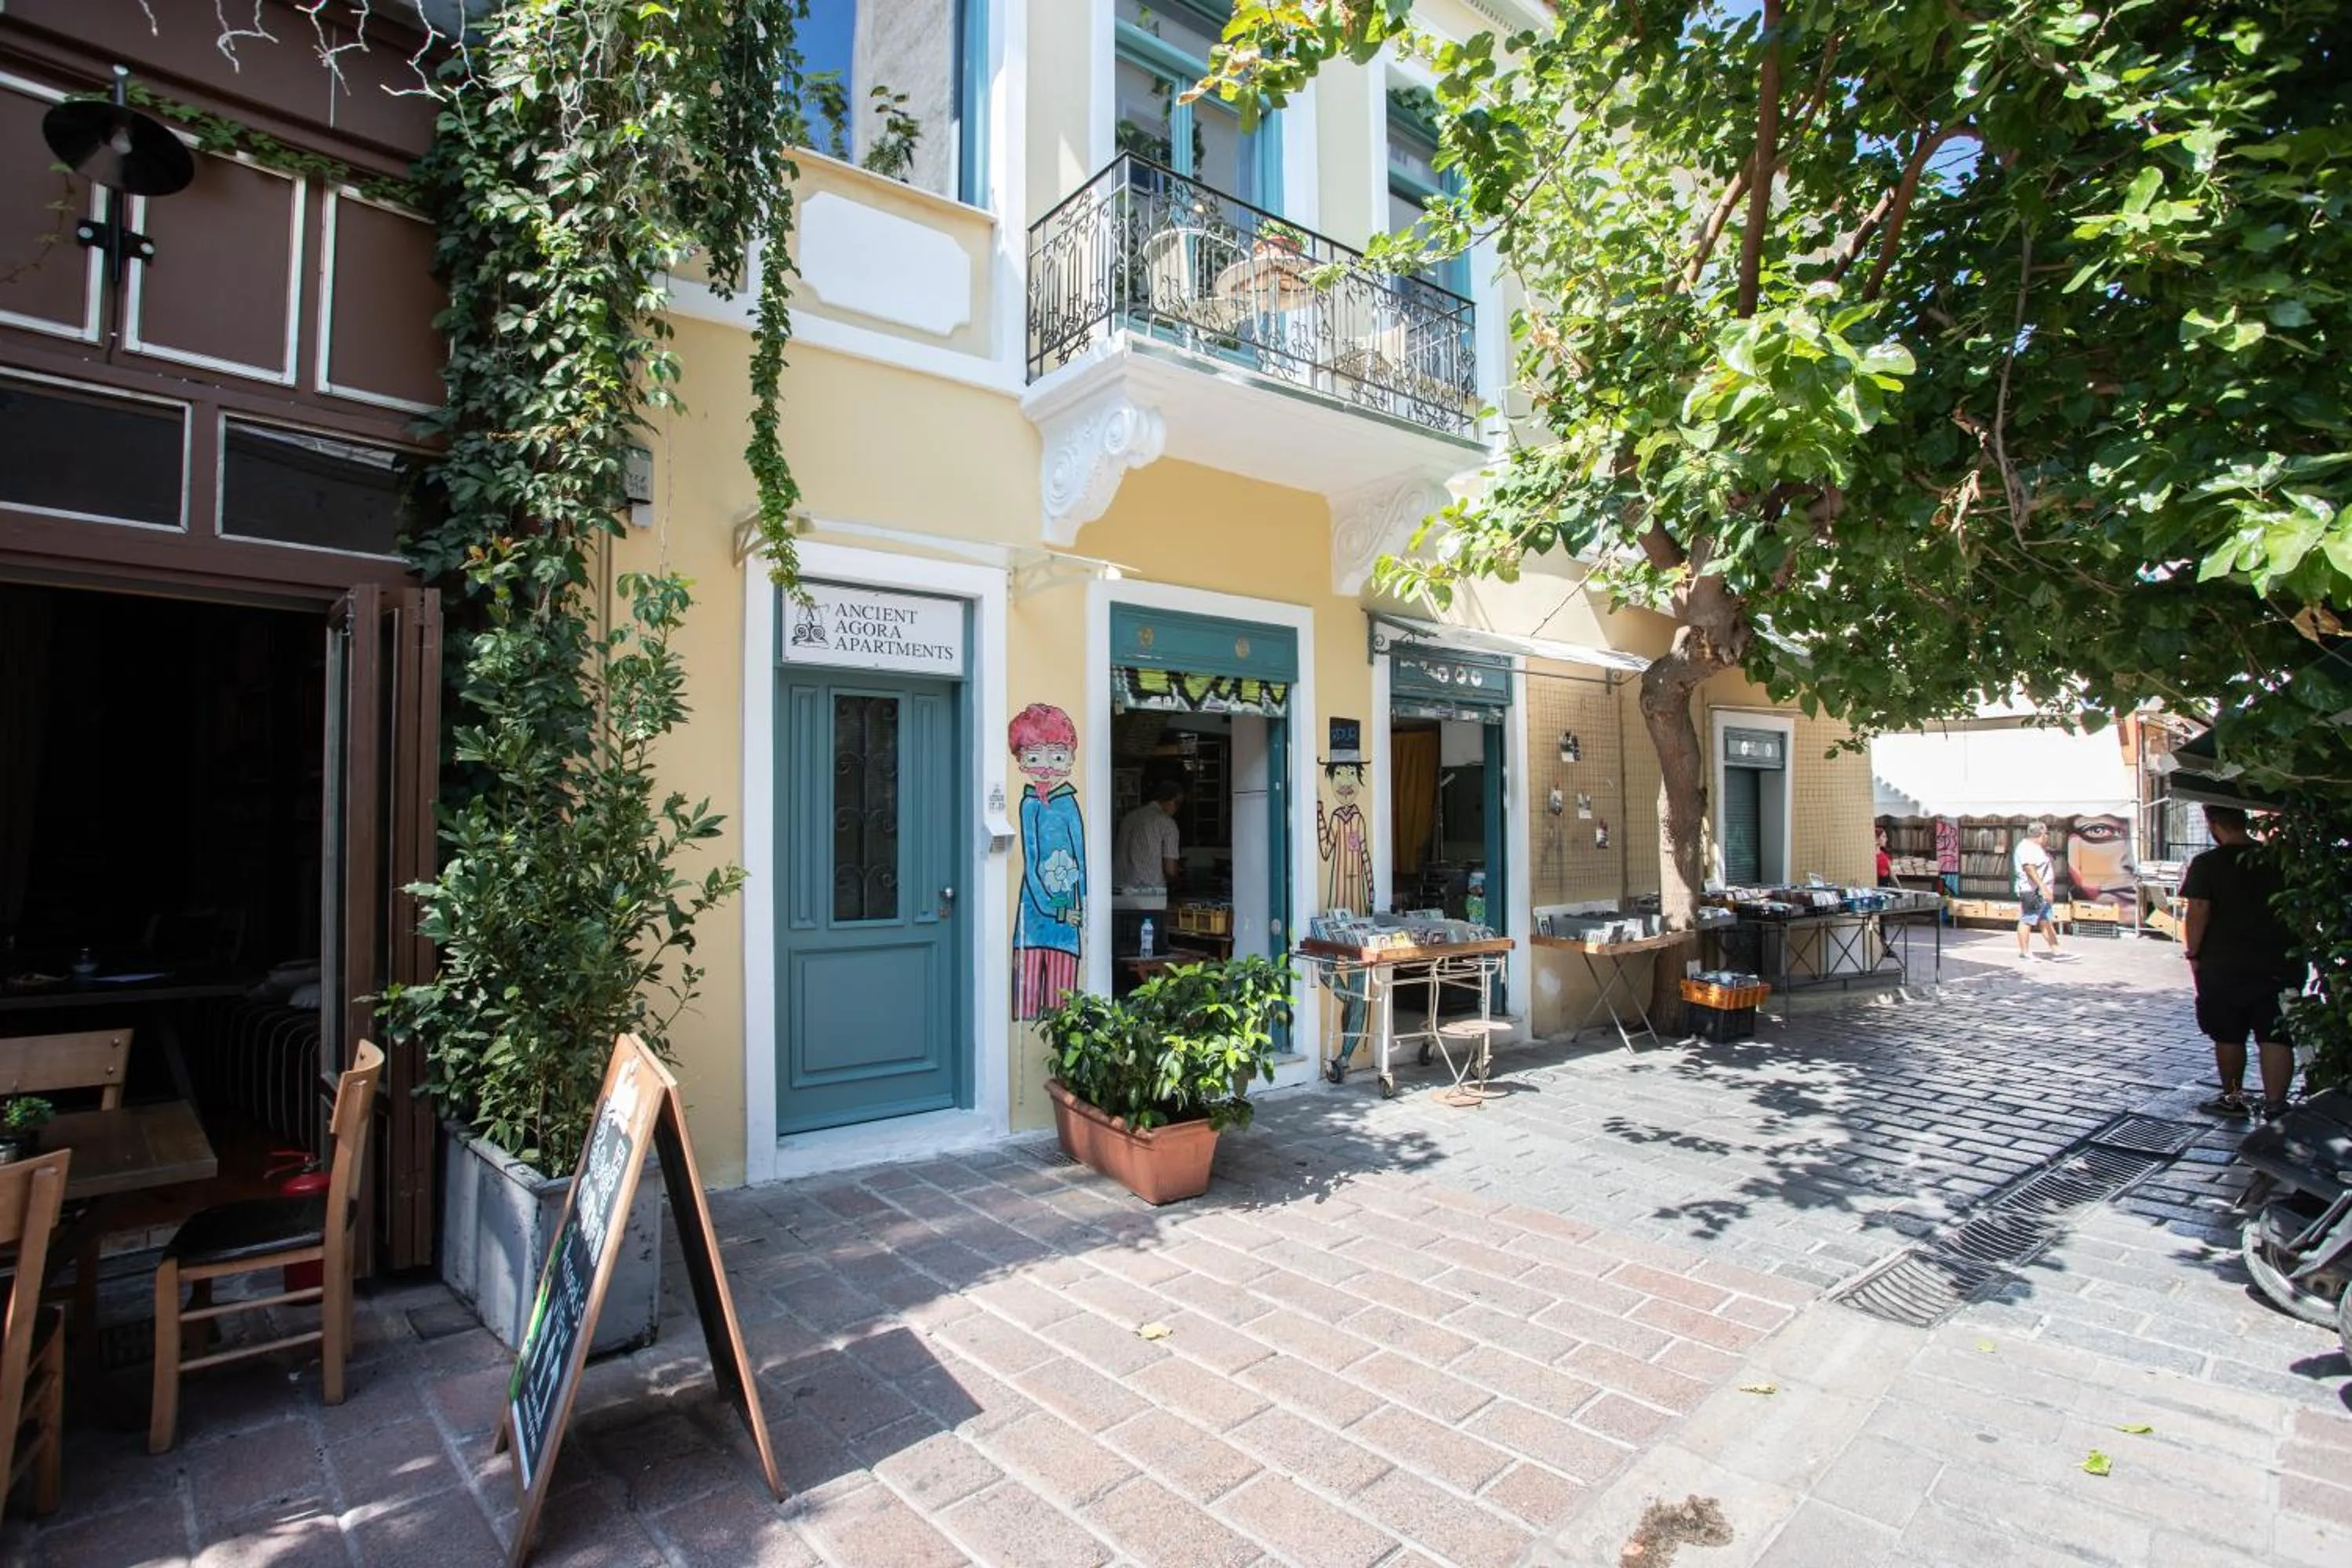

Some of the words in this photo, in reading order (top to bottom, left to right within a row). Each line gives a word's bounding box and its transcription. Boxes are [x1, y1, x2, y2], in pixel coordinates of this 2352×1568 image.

[835, 603, 918, 624] ANCIENT
[835, 620, 902, 639] AGORA
[834, 636, 954, 661] APARTMENTS
